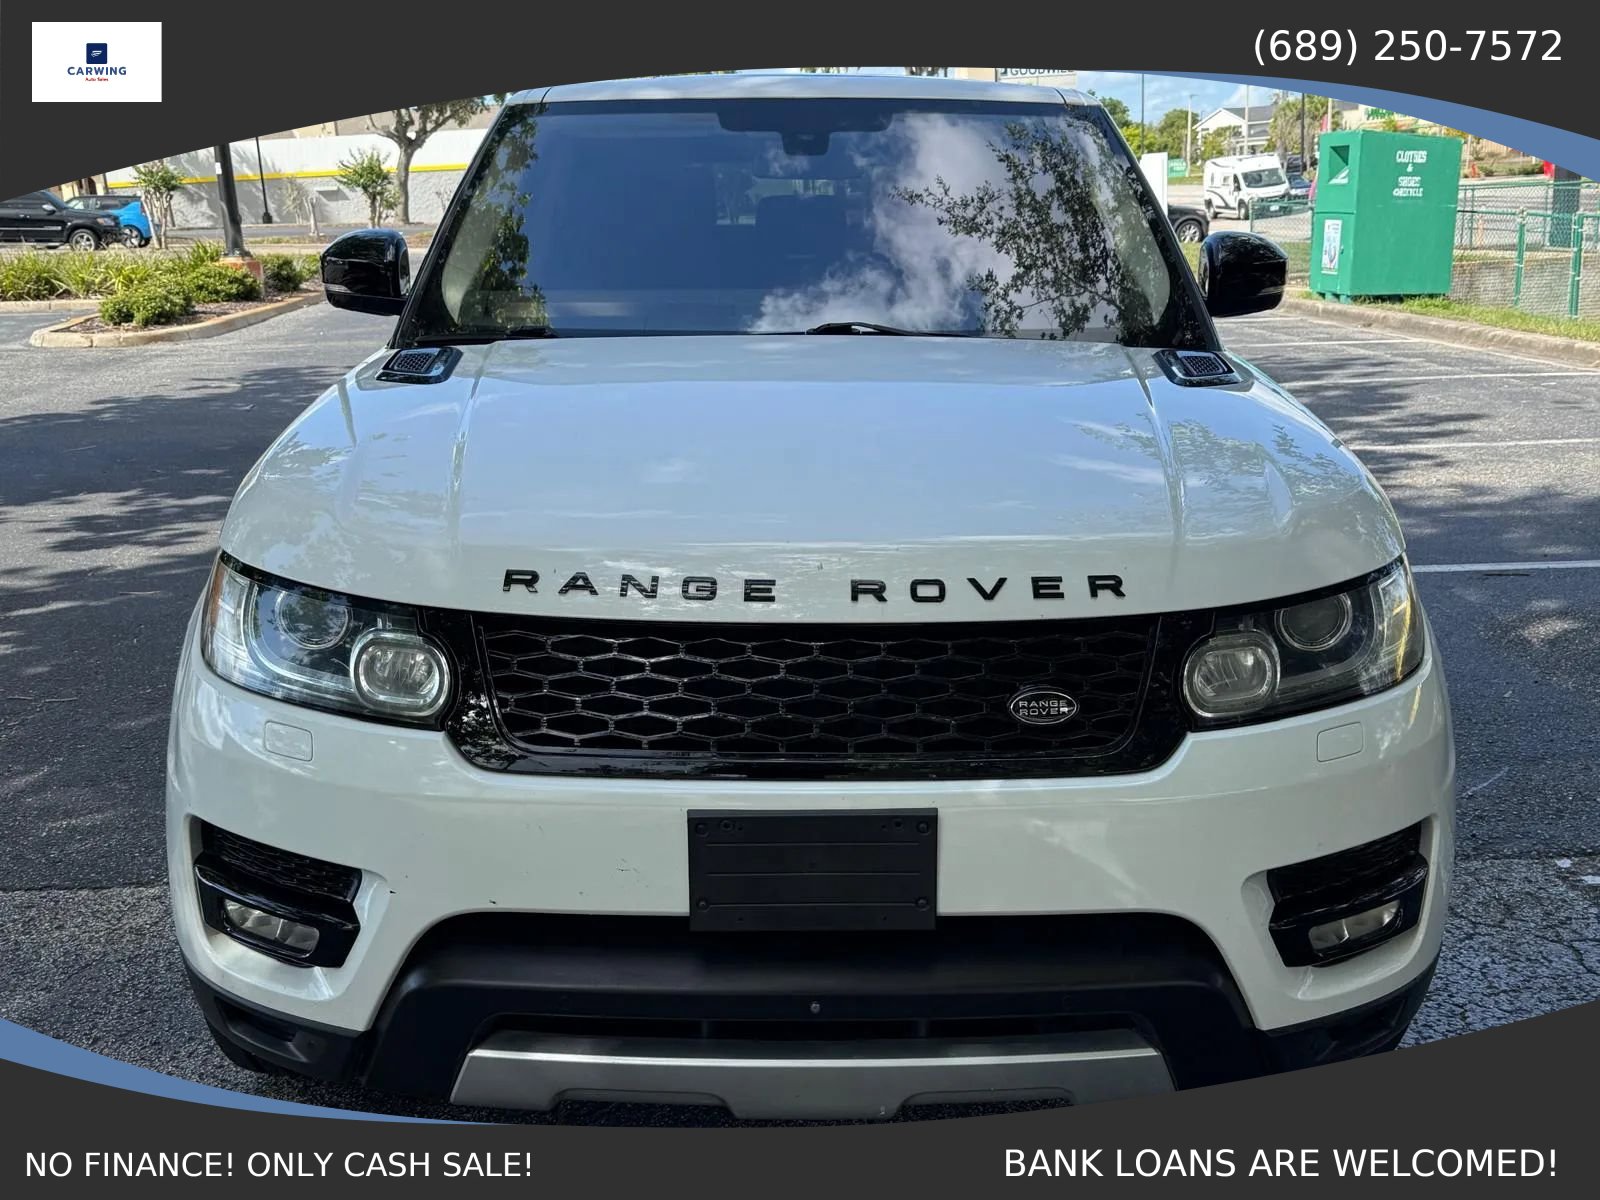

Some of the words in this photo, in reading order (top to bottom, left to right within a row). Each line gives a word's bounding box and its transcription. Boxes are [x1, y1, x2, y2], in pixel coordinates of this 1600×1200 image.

[1396, 150, 1427, 163] CLOTHES
[1398, 176, 1421, 187] SHOES
[502, 568, 777, 602] RANGE
[850, 574, 1127, 603] ROVER
[1019, 707, 1069, 716] ROVER
